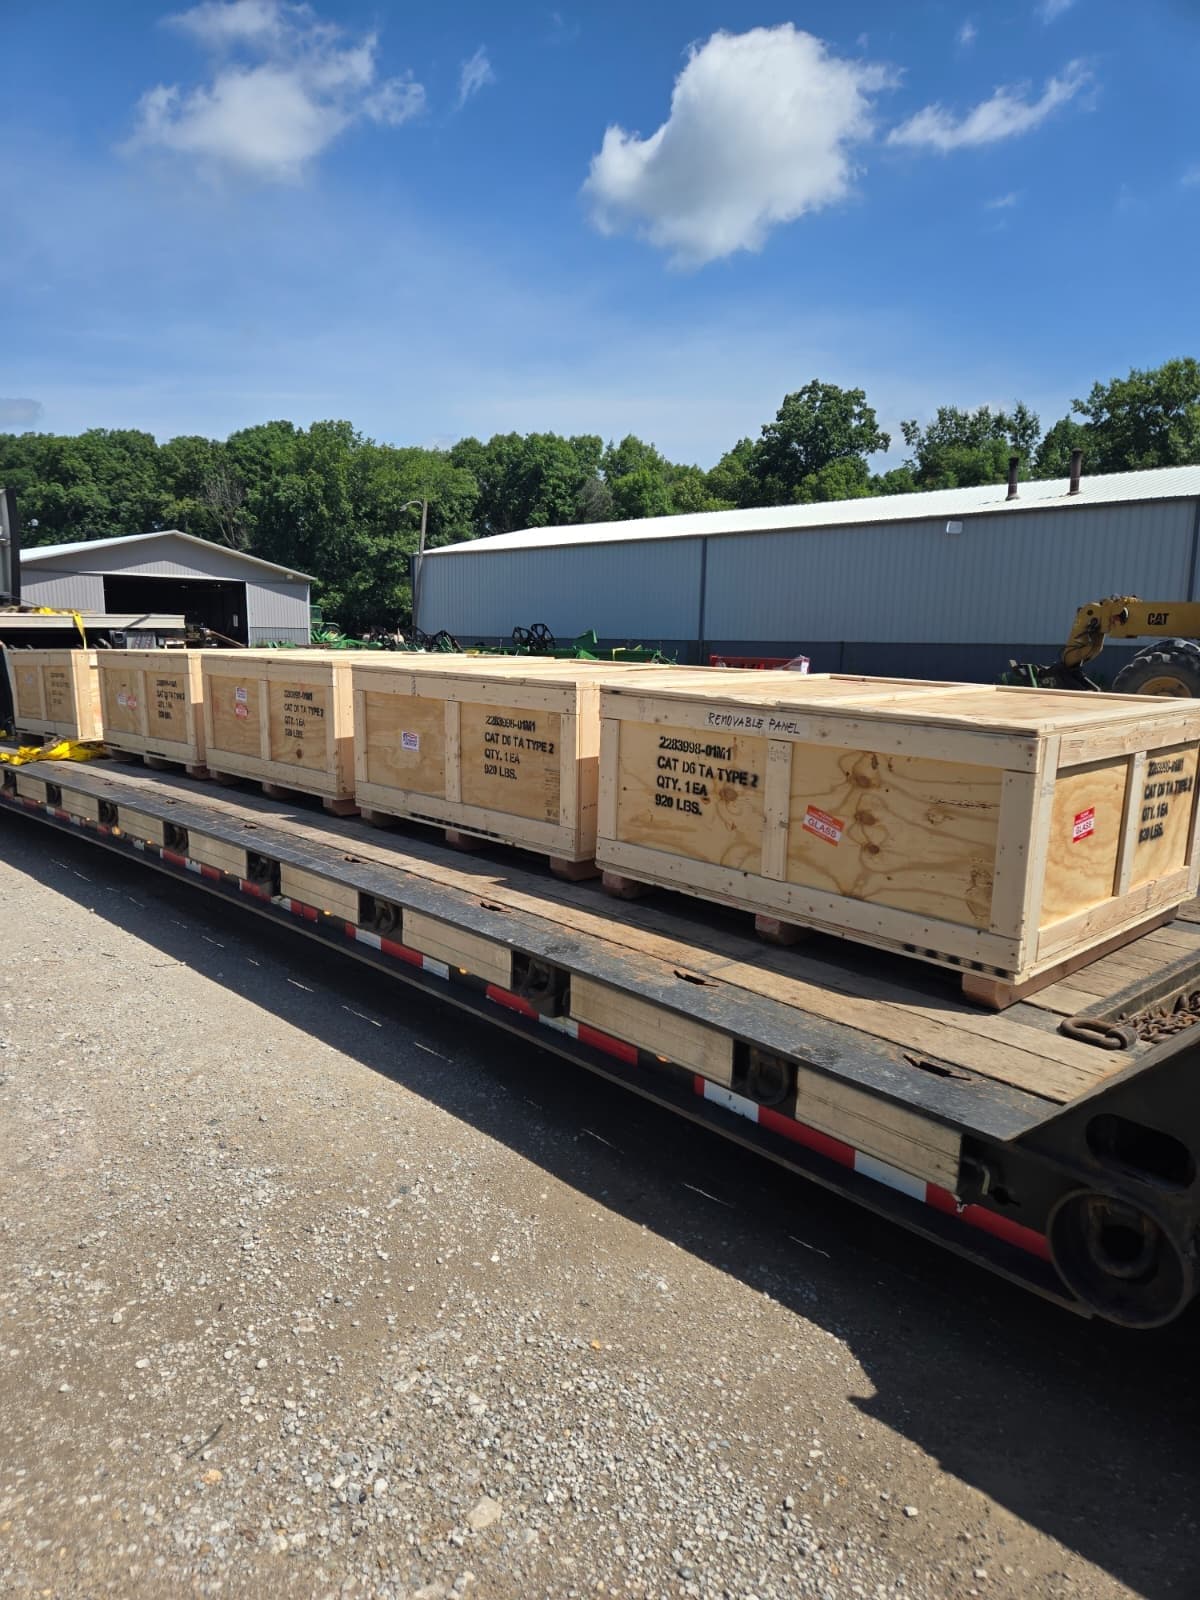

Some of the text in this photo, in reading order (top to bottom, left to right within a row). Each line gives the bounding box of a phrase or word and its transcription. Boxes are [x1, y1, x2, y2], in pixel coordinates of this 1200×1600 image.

[1148, 613, 1169, 625] CAT
[708, 712, 800, 734] REMOVABLE PANEL
[484, 732, 500, 744] CAT
[513, 736, 524, 748] TA
[526, 739, 547, 753] TYPE
[549, 743, 555, 754] 2
[484, 748, 502, 761] QTY.
[500, 766, 517, 780] LBS.
[657, 756, 760, 788] CAT D6 TA TYPE 2
[657, 775, 681, 792] QTY.
[655, 793, 702, 816] 920 LBS.
